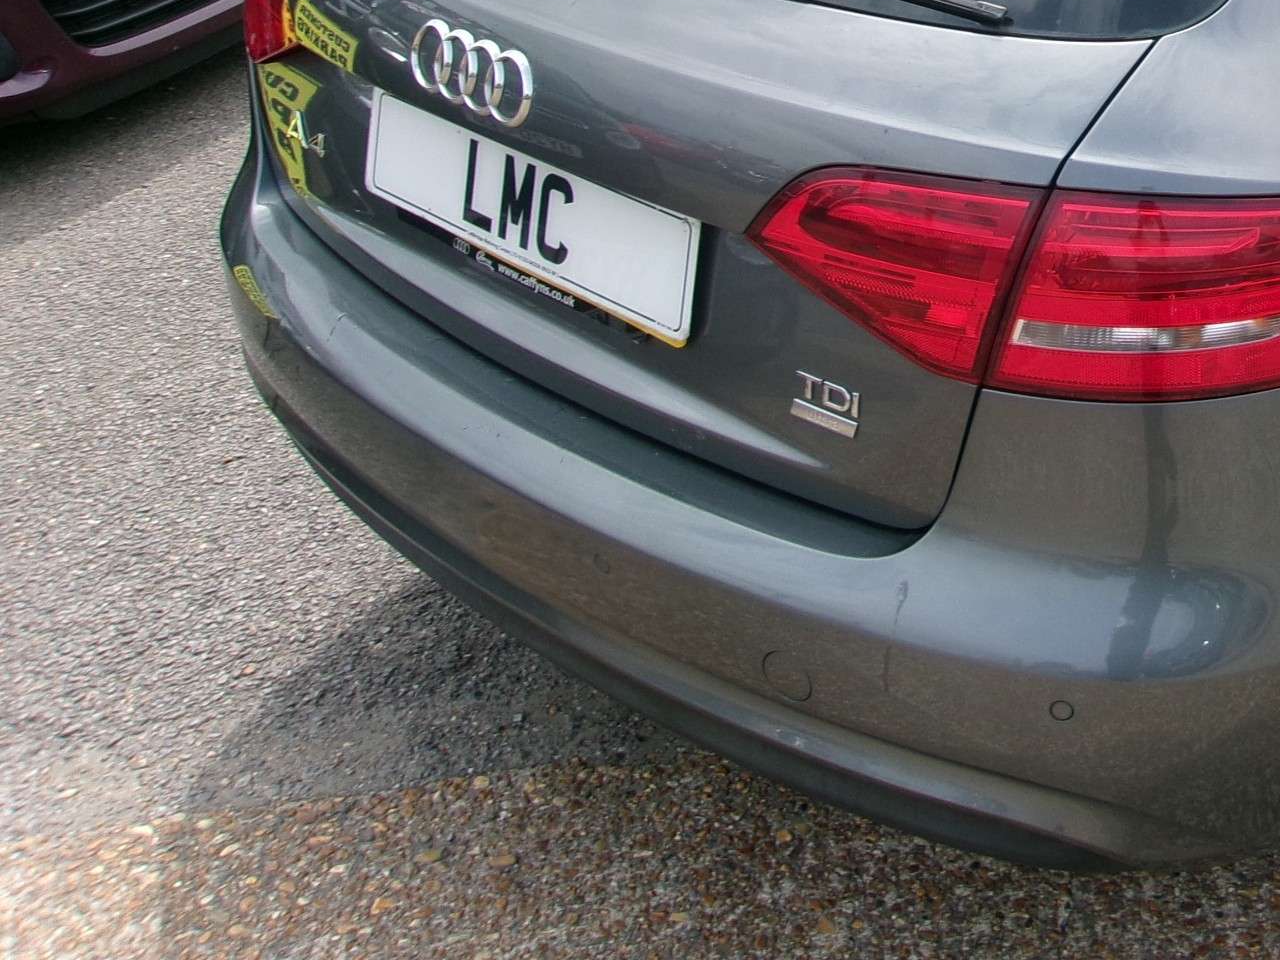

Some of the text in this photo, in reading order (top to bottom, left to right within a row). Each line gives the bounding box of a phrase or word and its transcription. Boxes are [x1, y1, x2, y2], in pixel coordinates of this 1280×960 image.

[287, 110, 325, 158] A4
[462, 138, 575, 265] LMC
[795, 370, 860, 419] TDI
